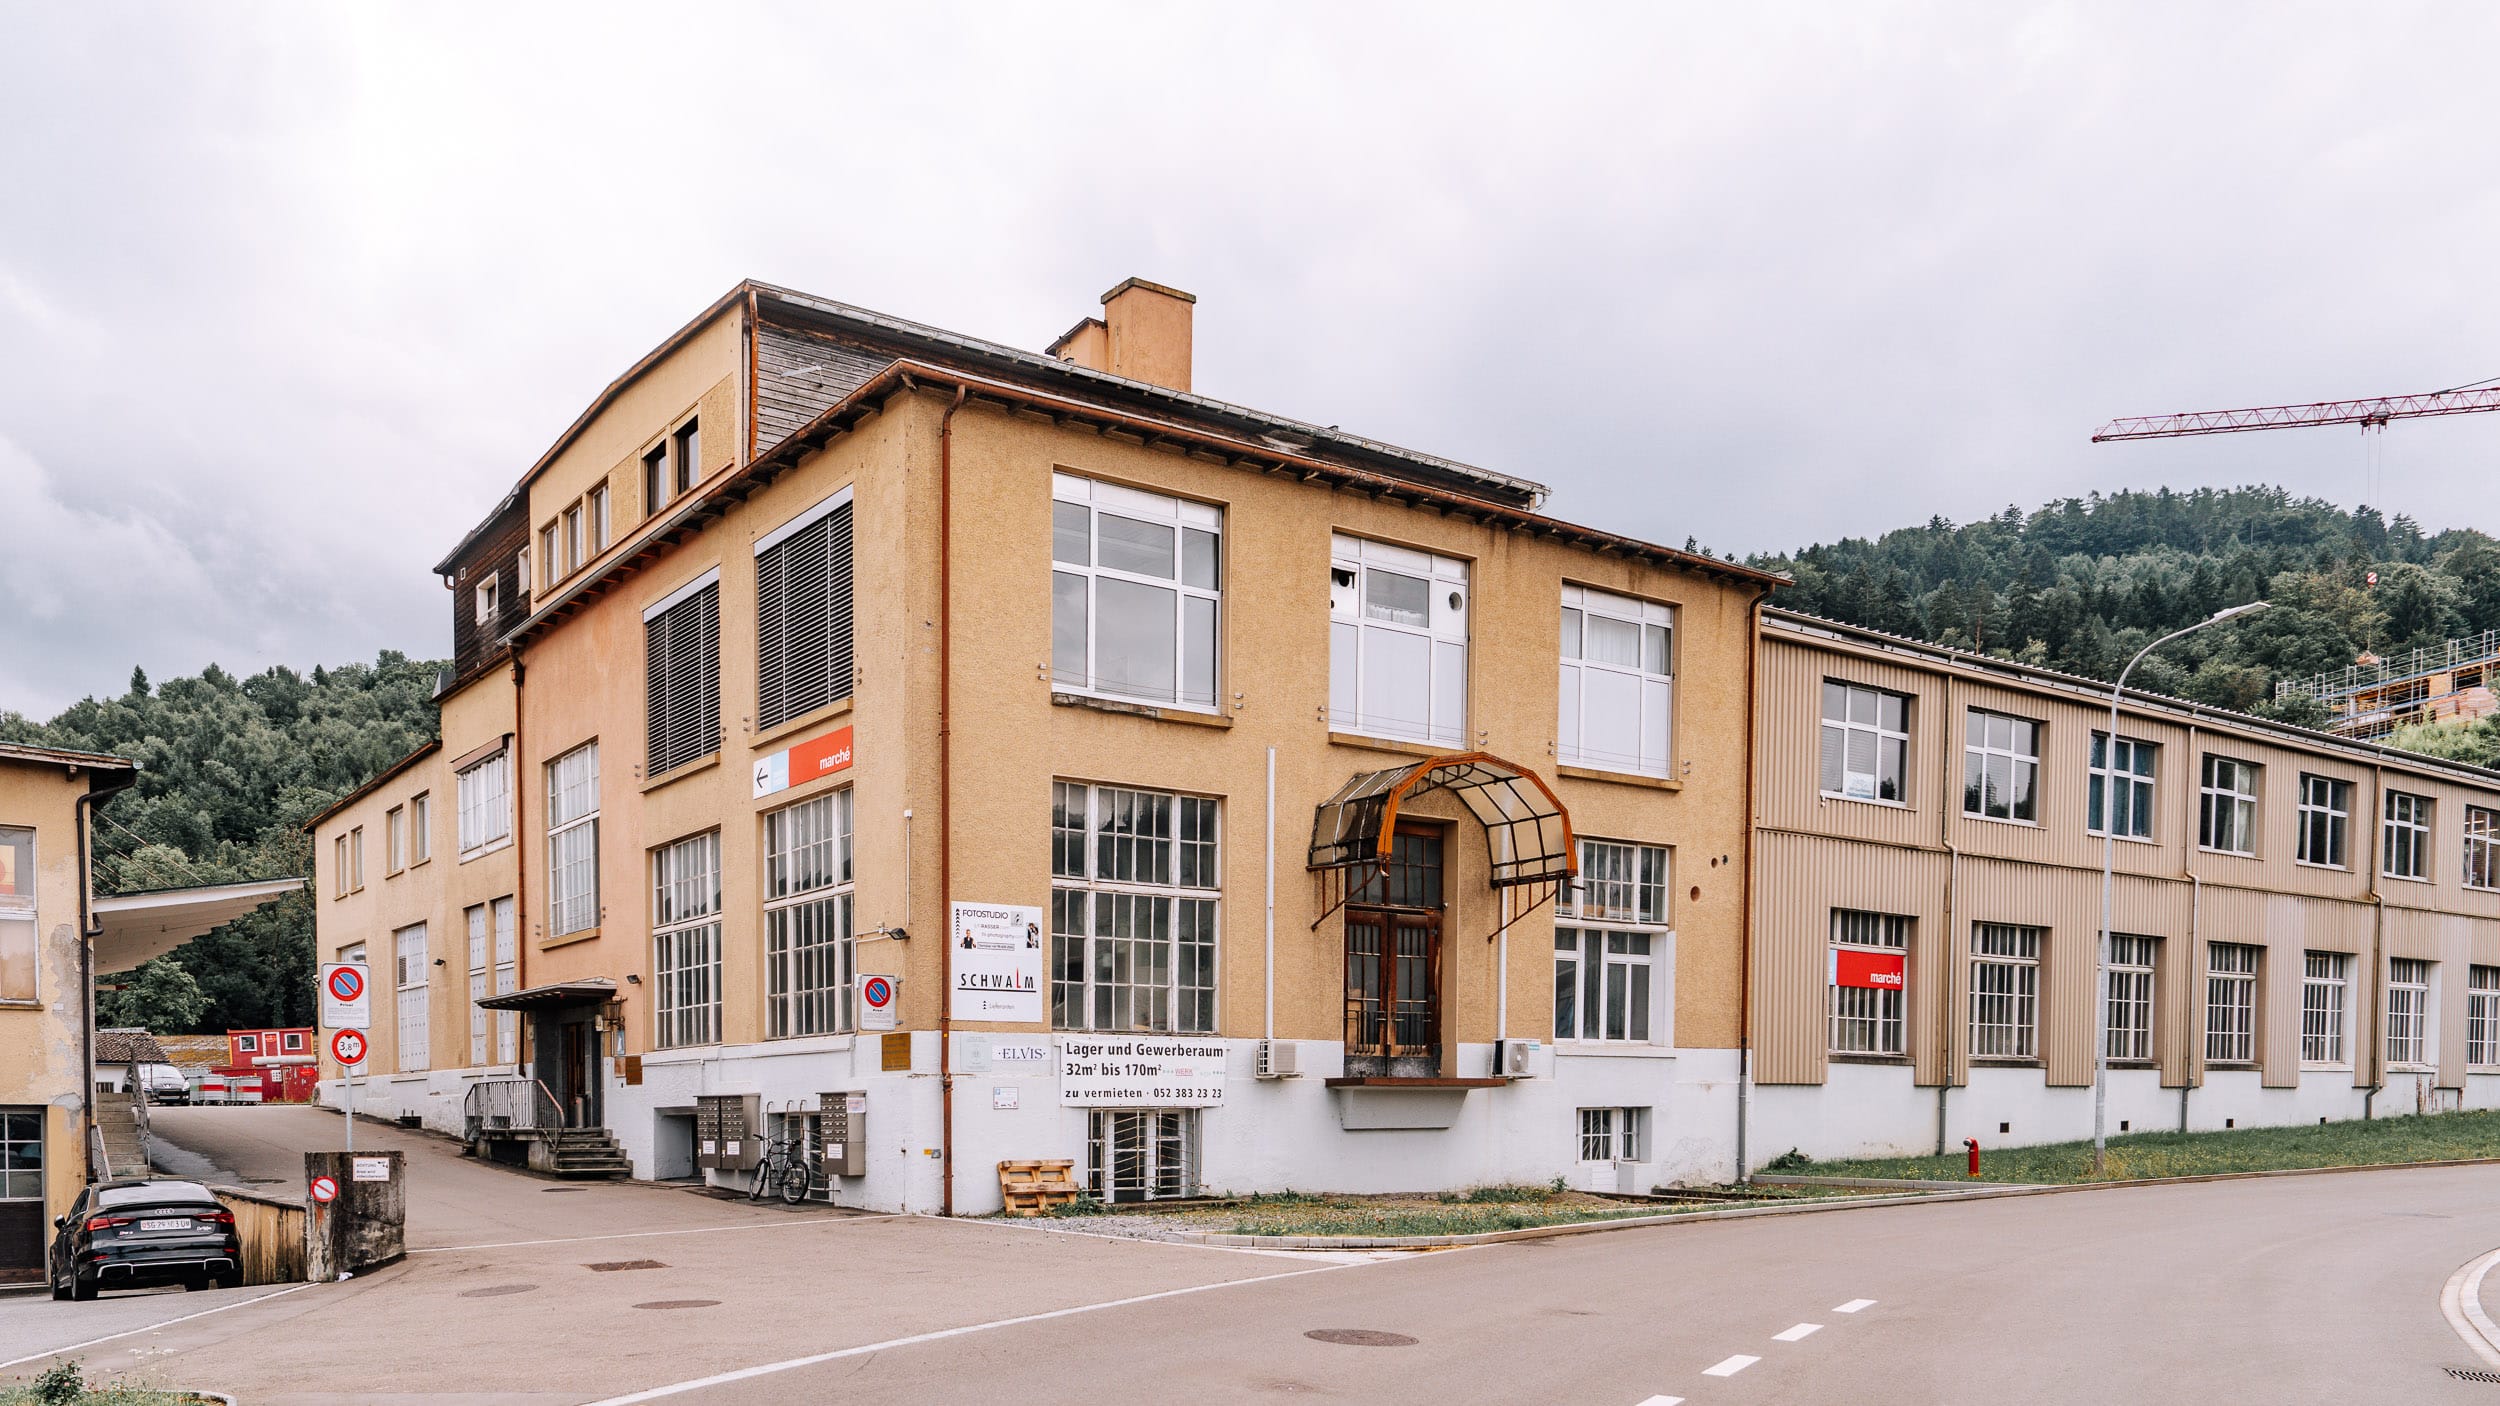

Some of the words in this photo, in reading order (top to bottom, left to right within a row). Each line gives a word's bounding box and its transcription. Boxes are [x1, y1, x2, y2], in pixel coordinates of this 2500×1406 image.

[819, 745, 851, 770] marché
[962, 909, 1009, 920] FOTOSTUDIO
[960, 966, 1034, 989] SCHWALM
[1870, 971, 1901, 985] marché
[1066, 1042, 1103, 1058] Lager
[1108, 1043, 1132, 1055] und
[1136, 1043, 1223, 1057] Gewerberaum
[1101, 1063, 1121, 1076] bis
[1065, 1089, 1079, 1098] zu
[1084, 1088, 1142, 1098] vermieten
[1153, 1088, 1171, 1098] 052
[1175, 1088, 1193, 1098] 383
[1197, 1088, 1208, 1098] 23
[1212, 1088, 1222, 1098] 23
